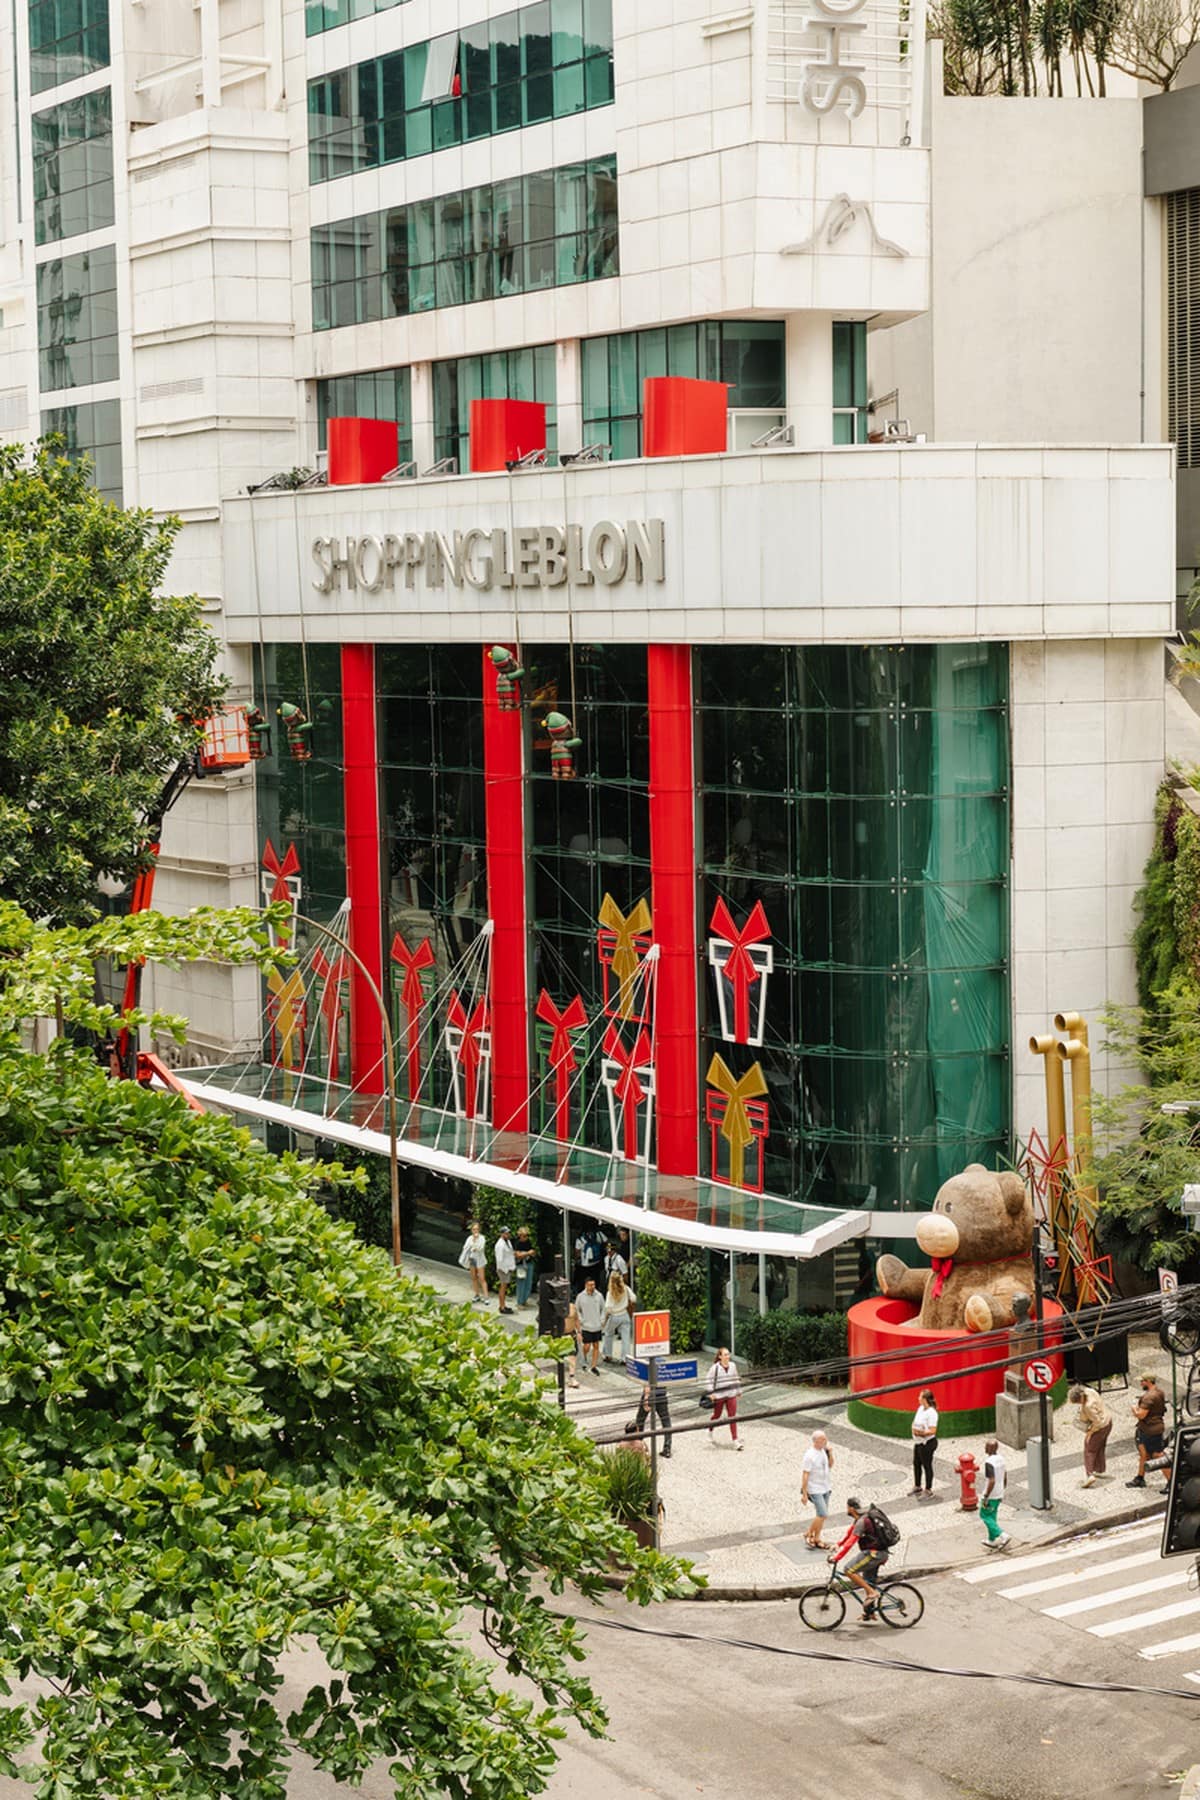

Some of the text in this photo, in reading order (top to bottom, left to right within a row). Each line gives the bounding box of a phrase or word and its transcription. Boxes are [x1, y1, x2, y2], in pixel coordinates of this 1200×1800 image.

[802, 0, 867, 118] SH
[311, 518, 665, 593] SHOPPING LEBLON
[1034, 1365, 1047, 1385] E
